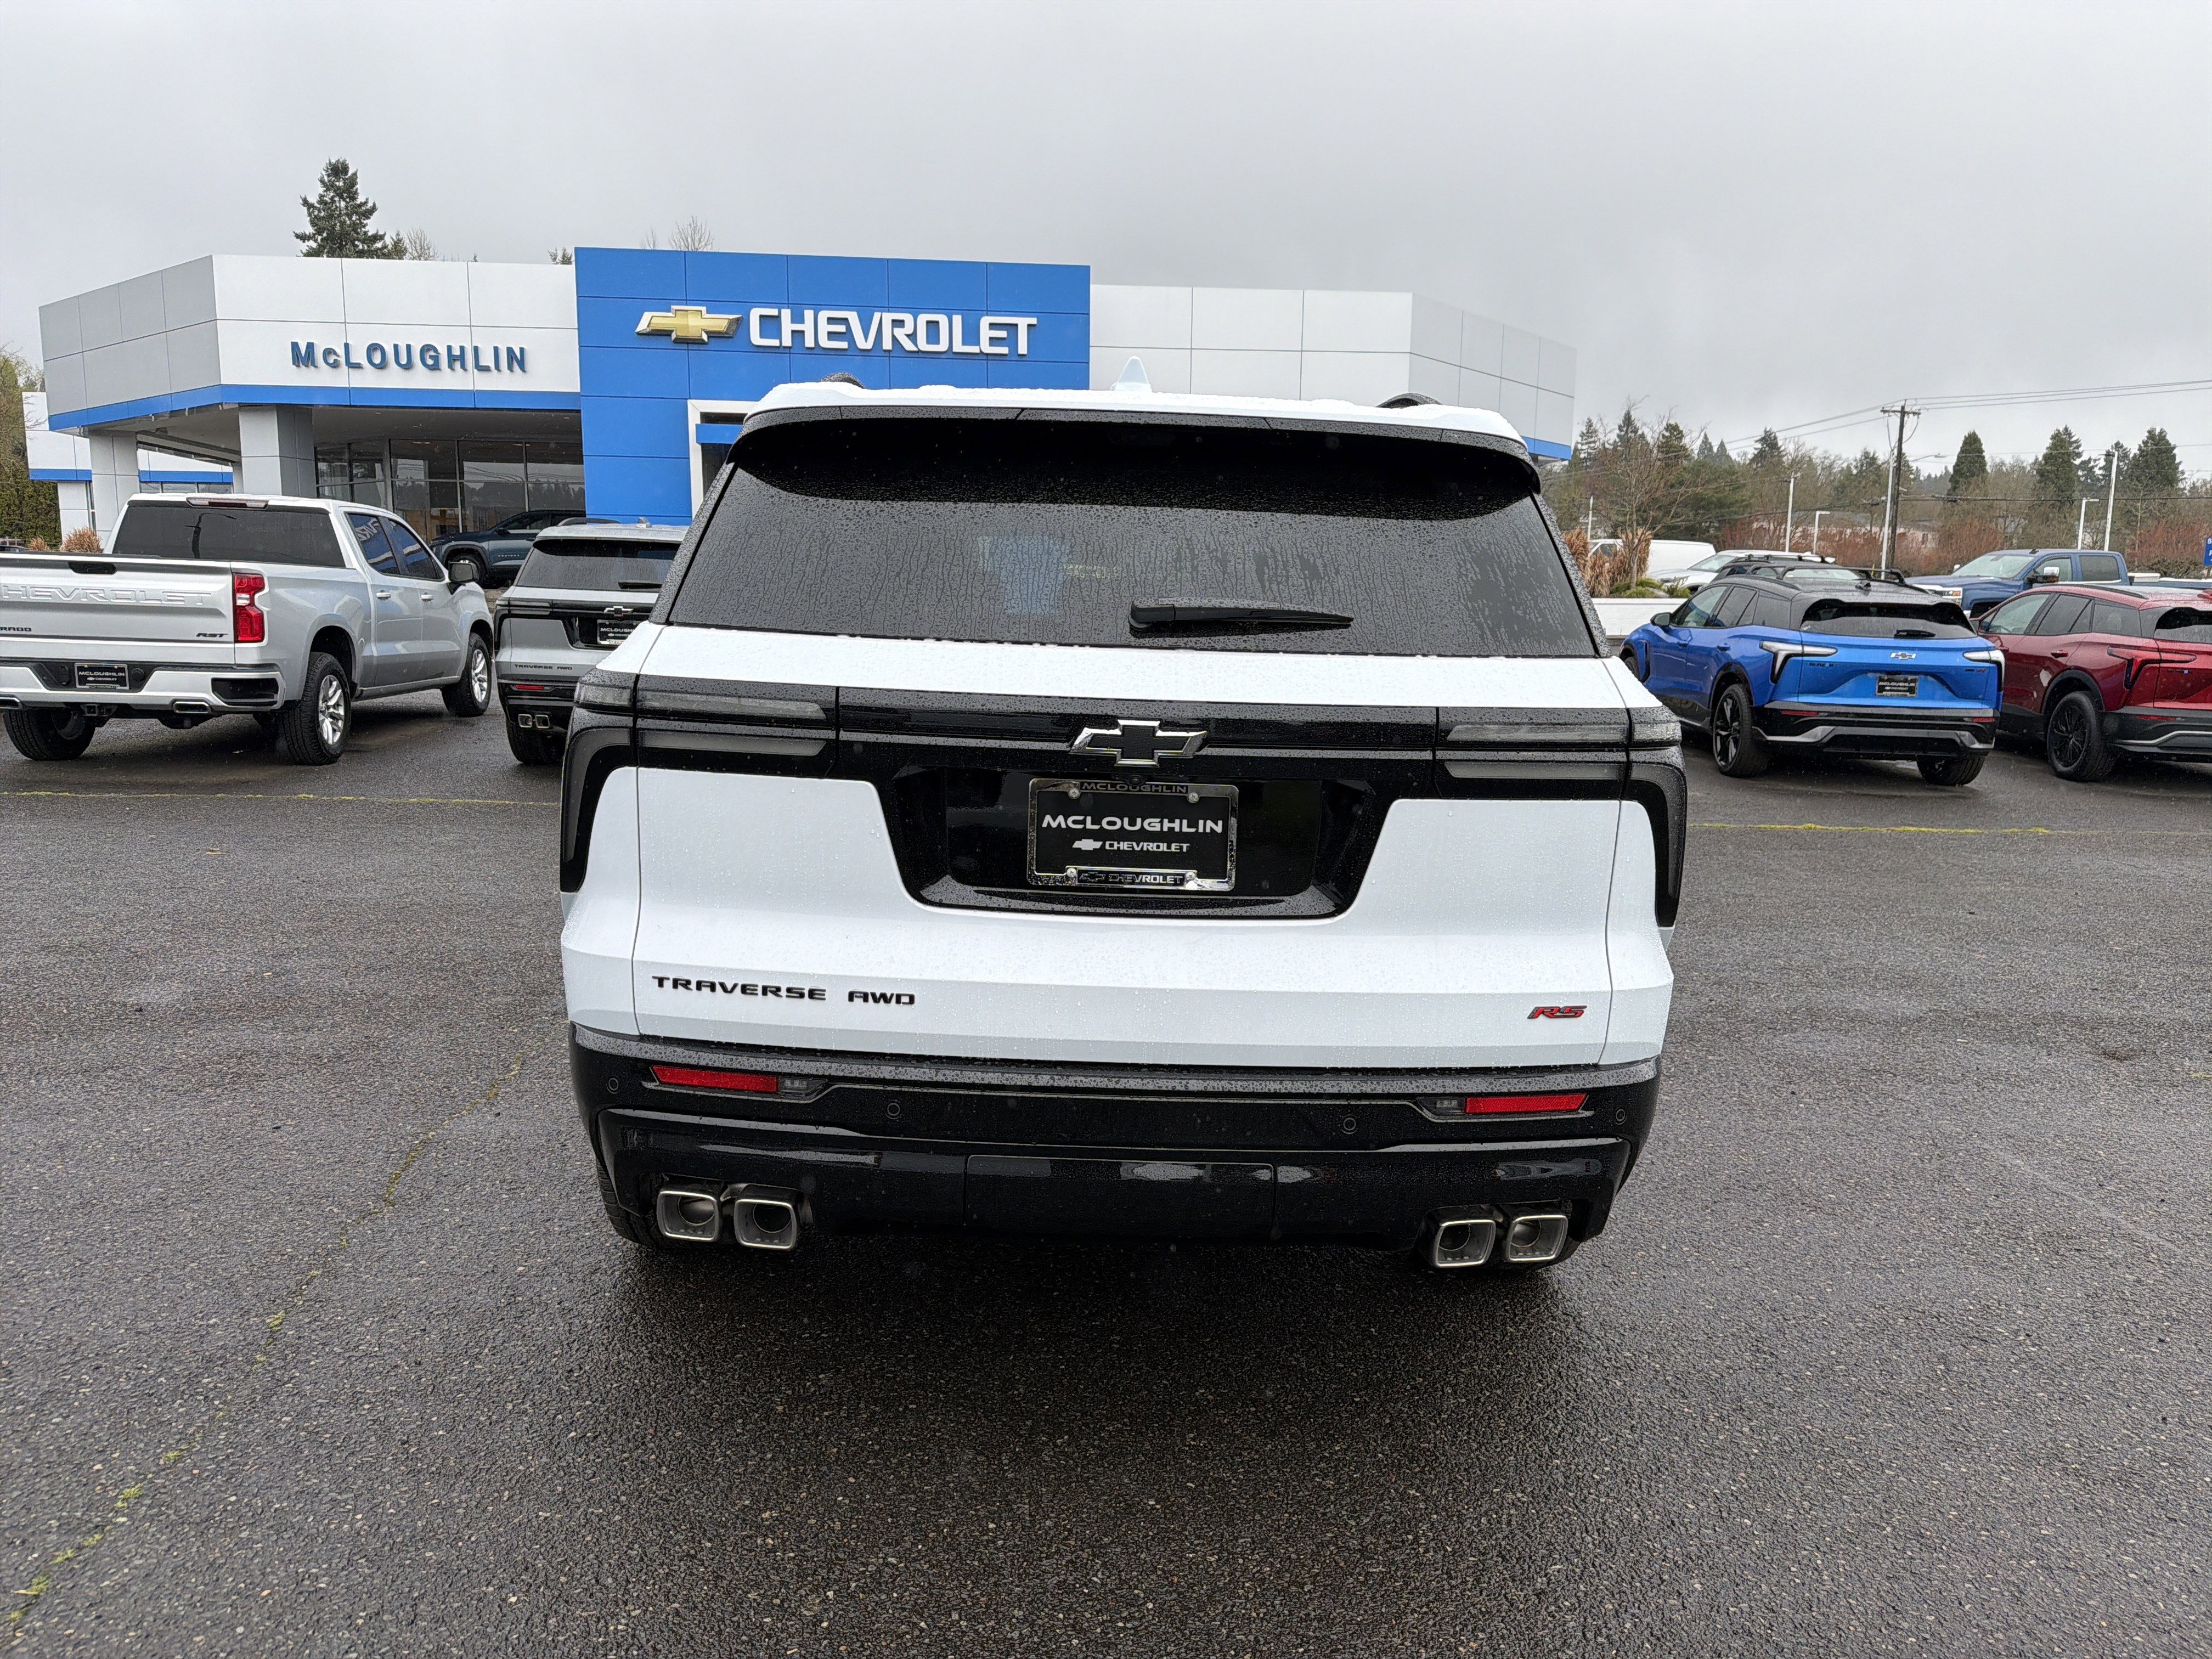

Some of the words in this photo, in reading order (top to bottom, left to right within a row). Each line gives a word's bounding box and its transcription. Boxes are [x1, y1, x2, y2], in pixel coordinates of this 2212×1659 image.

[749, 307, 1037, 356] CHEVROLET
[291, 341, 526, 373] McLOUGHLIN
[1082, 782, 1187, 793] MCLOUGHLIN
[1042, 814, 1223, 833] MCLOUGHLIN
[1105, 840, 1190, 853] CHEVROLET
[1108, 873, 1183, 884] CHEVROLET
[651, 975, 827, 1001] TRAVERSE
[848, 990, 916, 1005] AWD
[1527, 1005, 1588, 1019] RS
